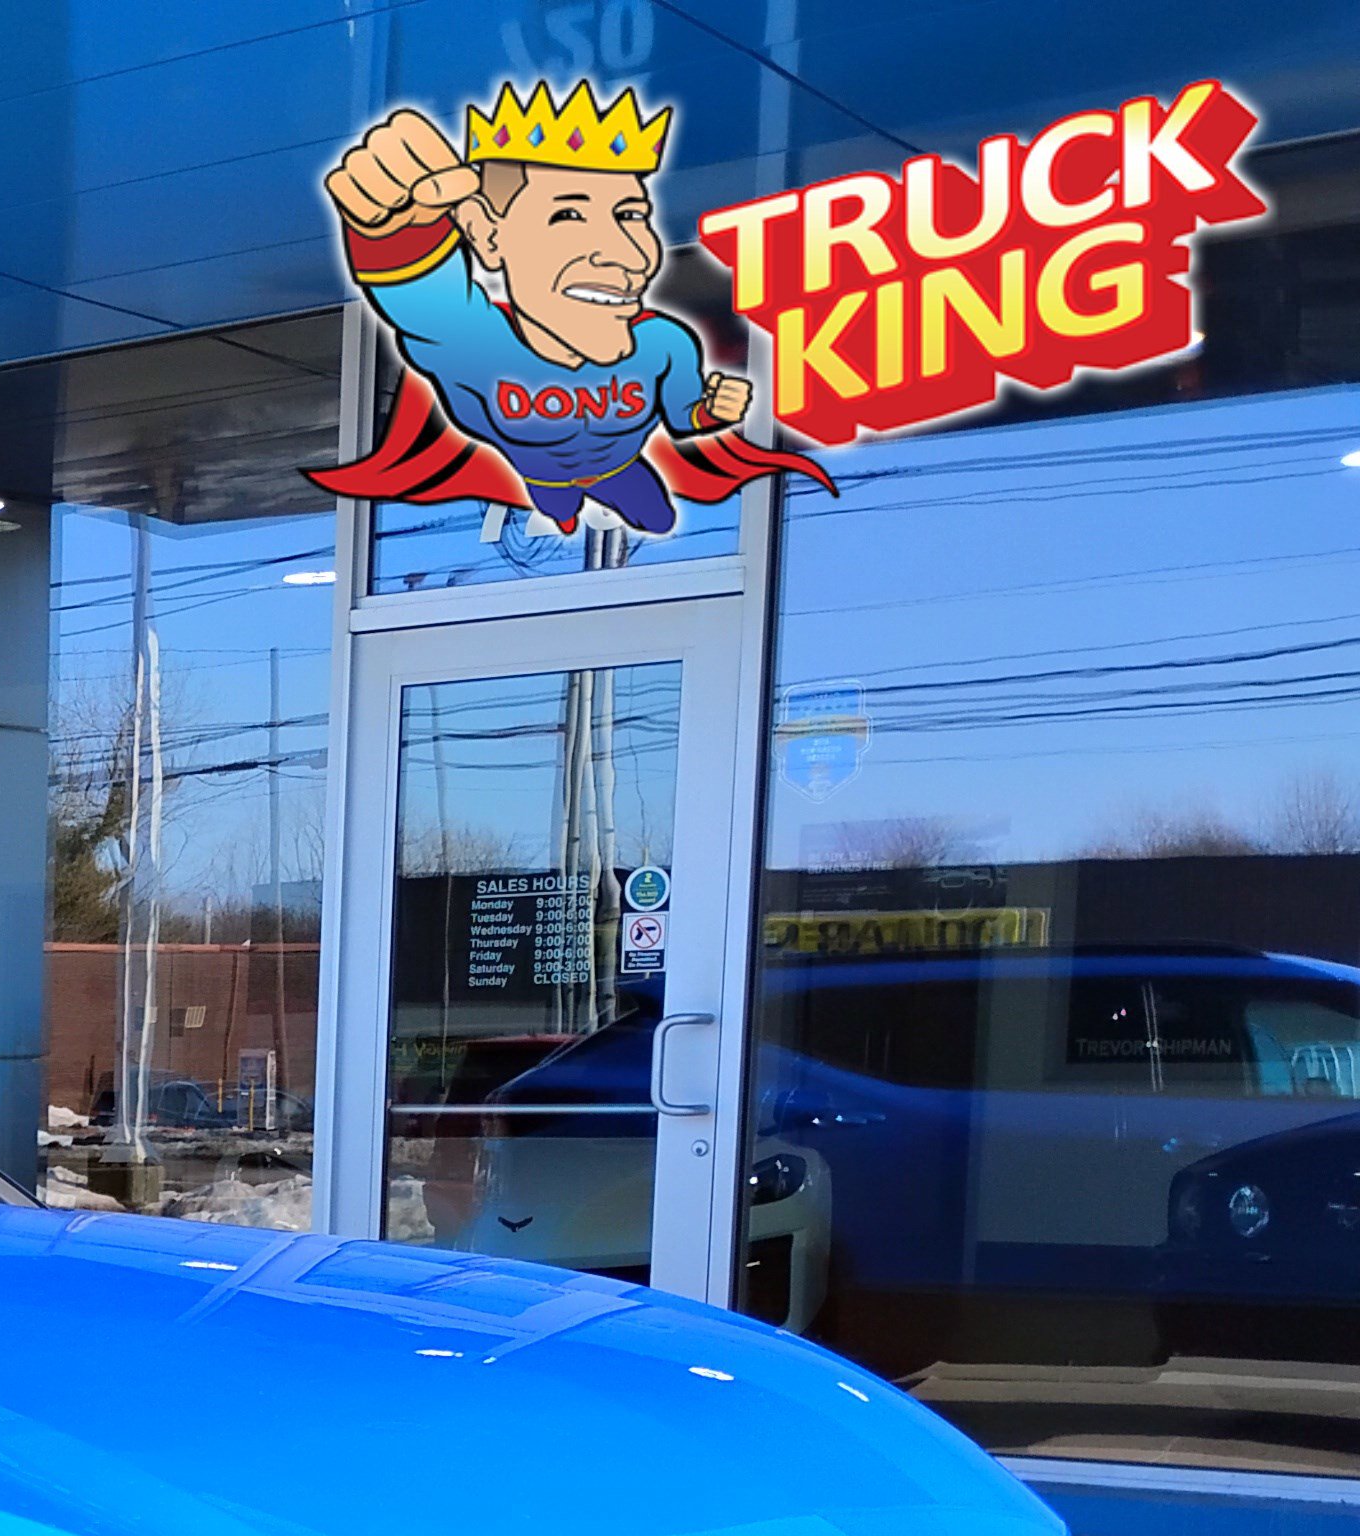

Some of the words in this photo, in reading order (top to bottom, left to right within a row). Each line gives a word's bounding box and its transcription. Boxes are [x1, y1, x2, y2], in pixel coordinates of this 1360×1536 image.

[477, 878, 528, 893] SALES
[533, 875, 590, 890] HOURS
[471, 900, 514, 910] Monday
[471, 912, 514, 923] Tuesday
[470, 925, 533, 936] Wednesday
[470, 938, 519, 949] Thursday
[469, 951, 502, 962] Friday
[469, 963, 516, 975] Saturday
[468, 976, 508, 988] Sunday
[534, 972, 589, 985] CLOSED
